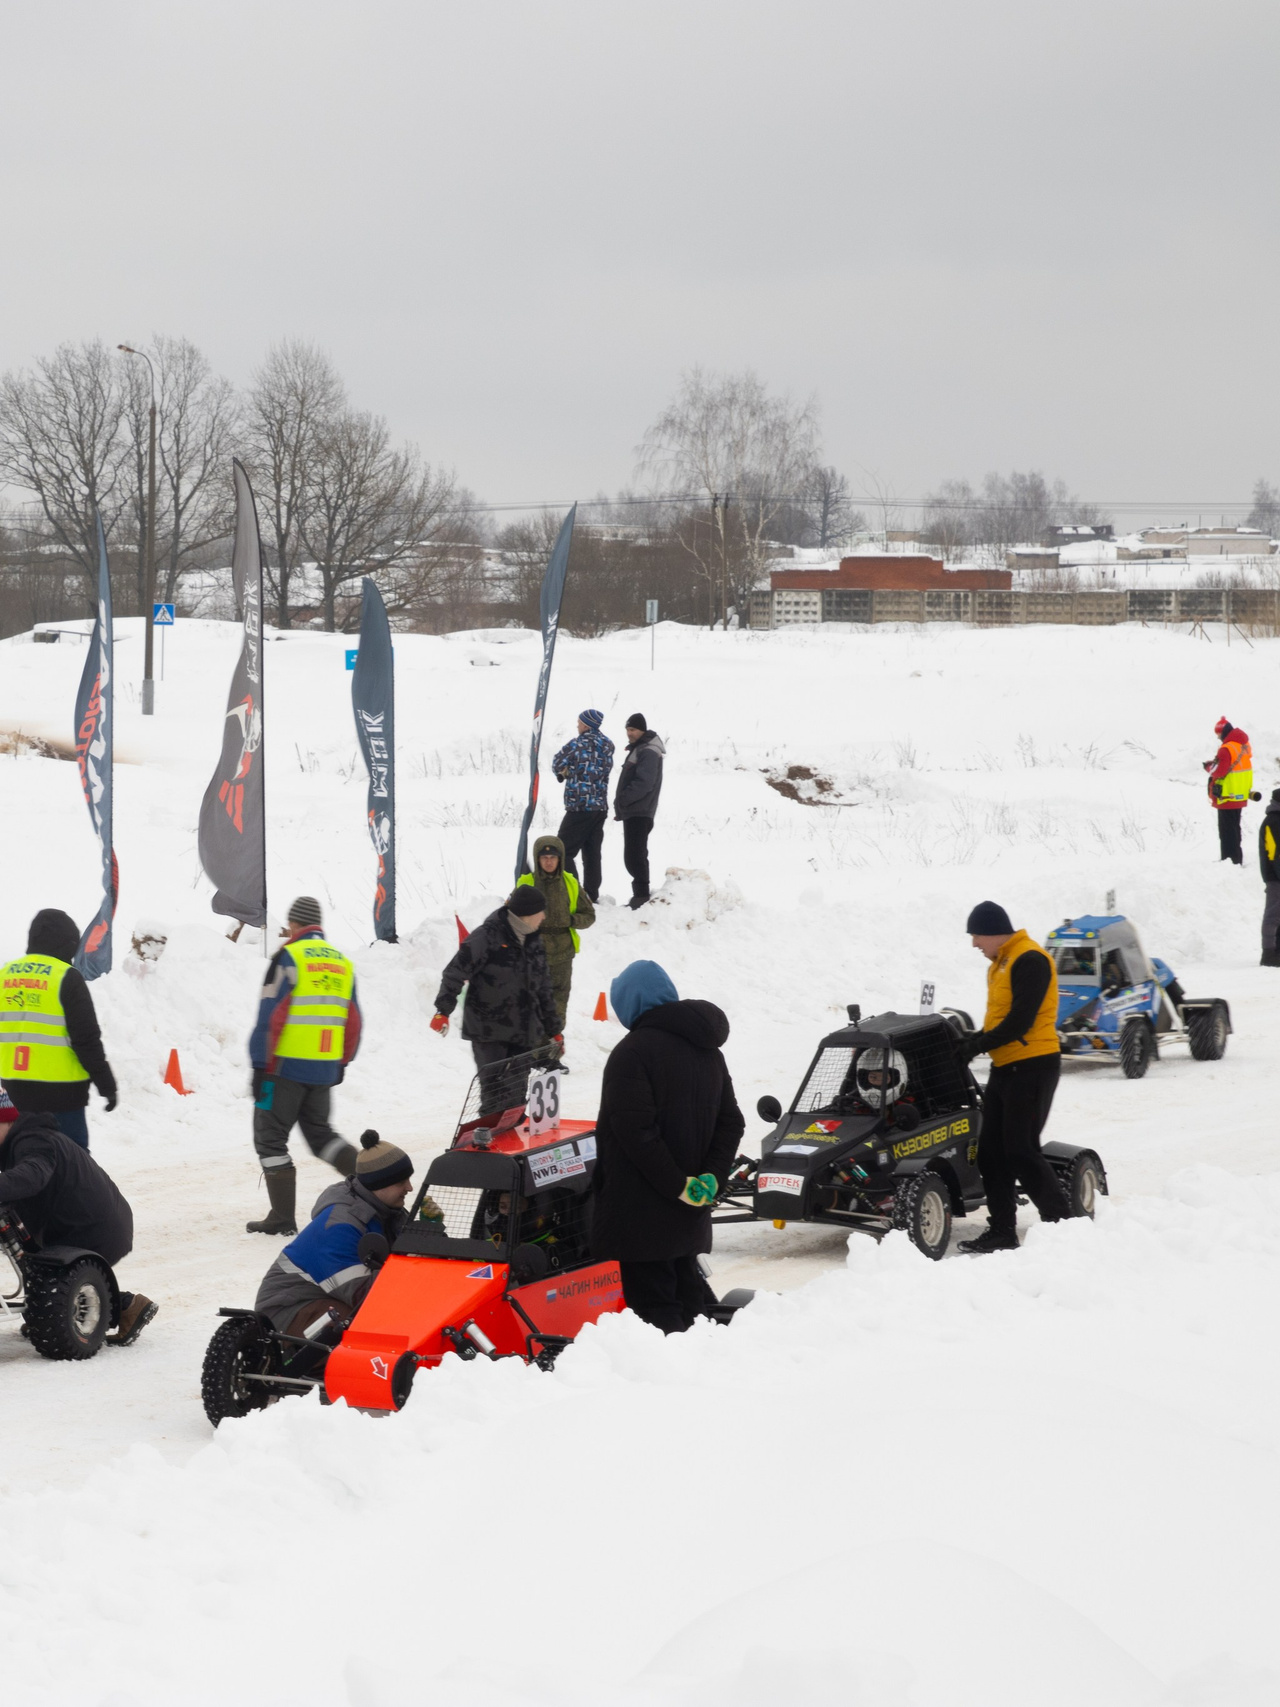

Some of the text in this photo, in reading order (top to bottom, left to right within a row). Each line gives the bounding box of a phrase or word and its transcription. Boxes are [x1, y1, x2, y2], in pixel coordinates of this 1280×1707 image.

[8, 962, 53, 976] RUSTA
[921, 984, 935, 1006] 69
[532, 1076, 559, 1123] 33
[893, 1126, 948, 1159] КУЗОВЛЕВ
[948, 1118, 970, 1138] ЛЕВ
[533, 1165, 559, 1180] NWB
[559, 1279, 590, 1299] ЧАГИН
